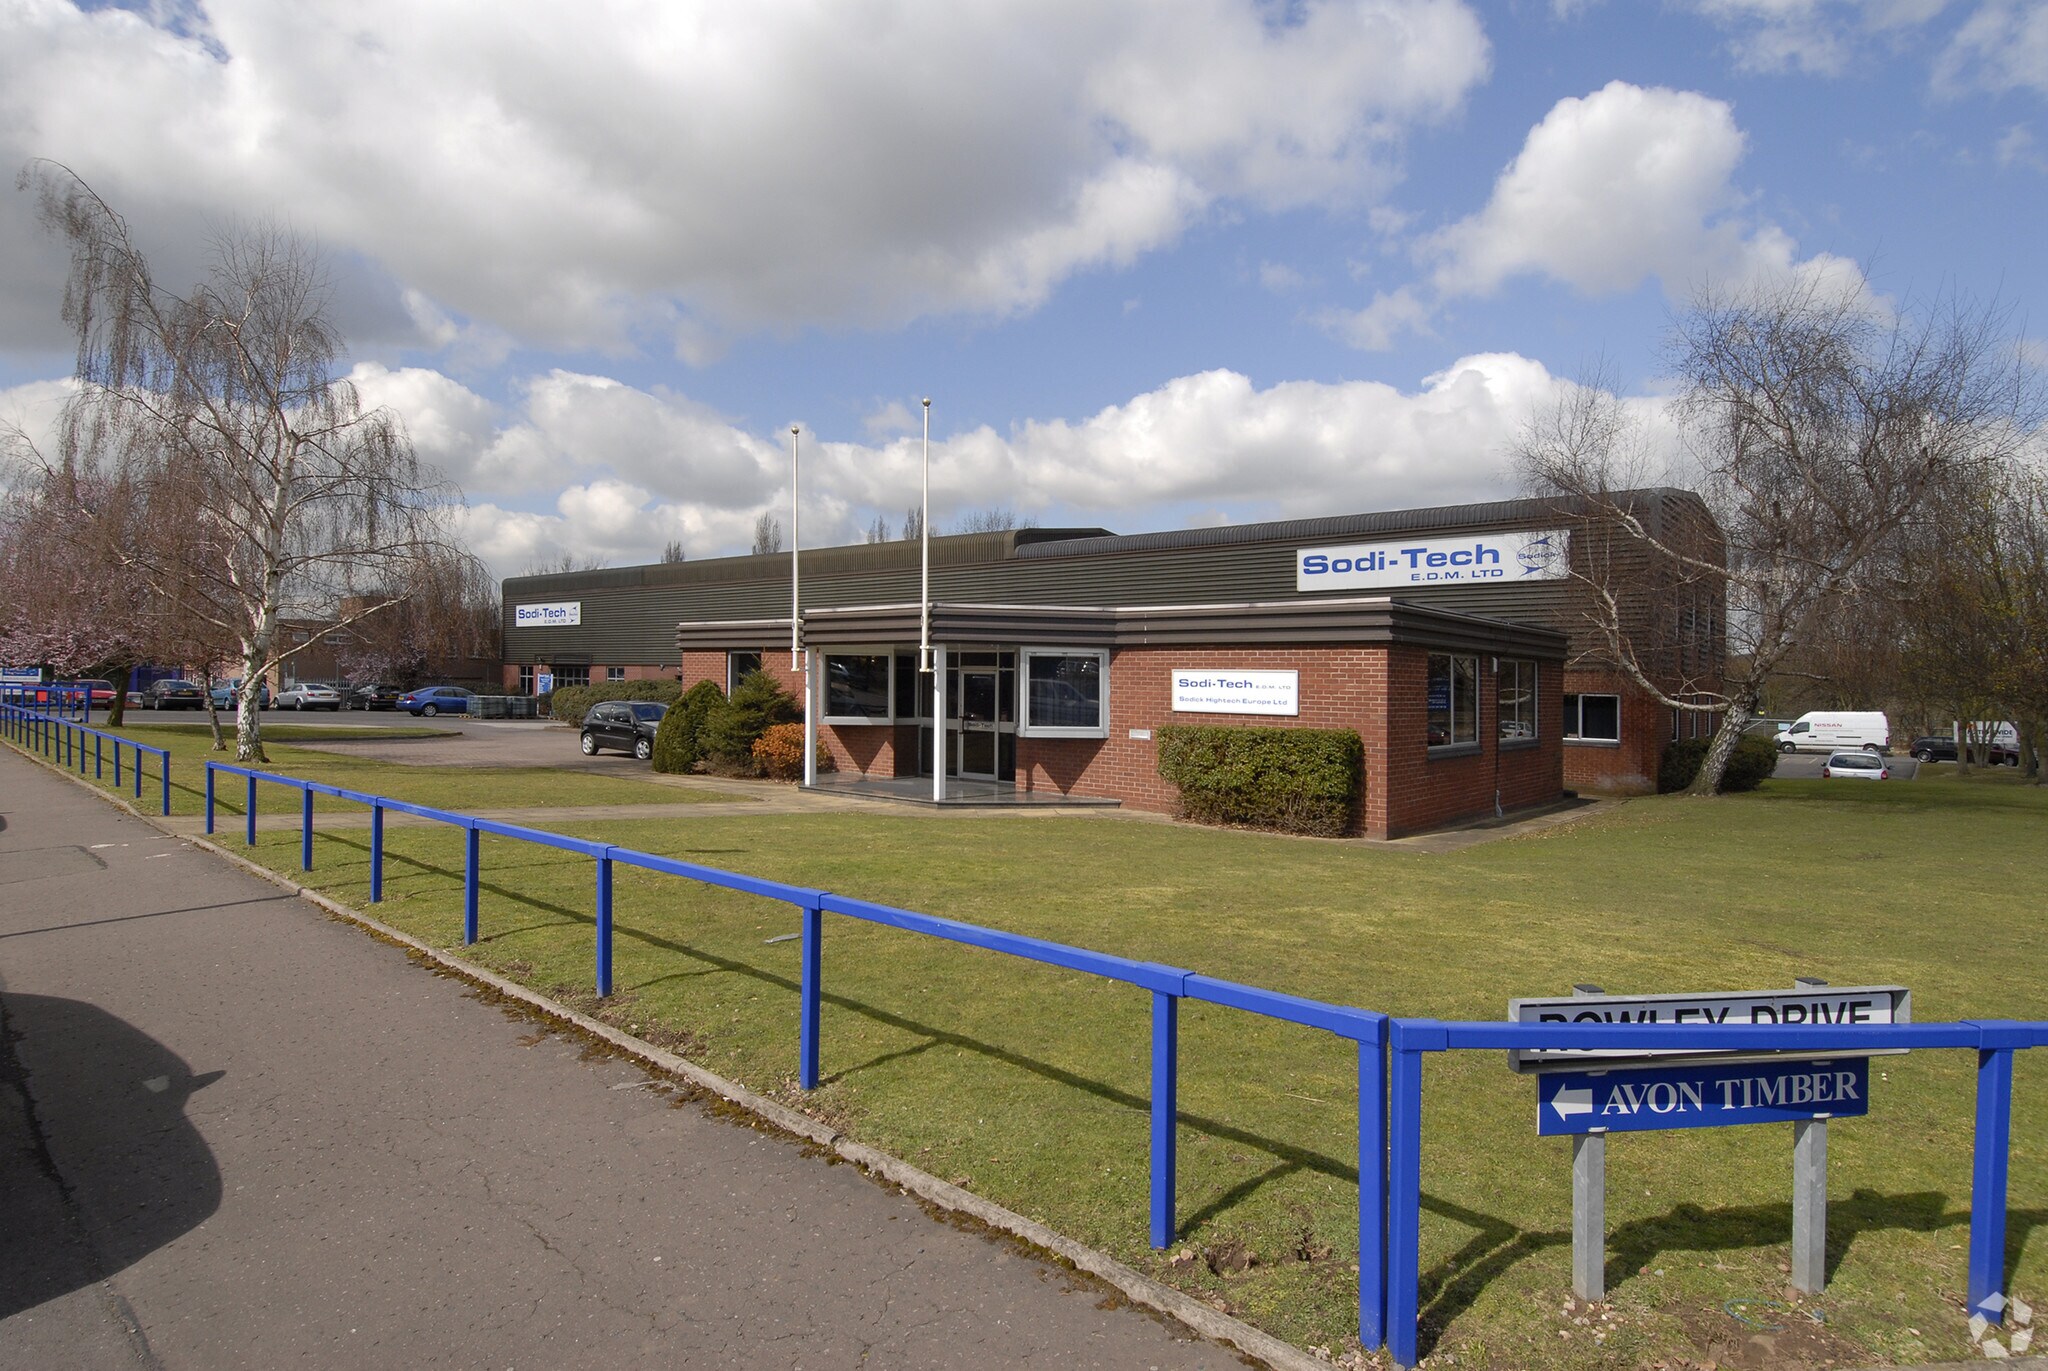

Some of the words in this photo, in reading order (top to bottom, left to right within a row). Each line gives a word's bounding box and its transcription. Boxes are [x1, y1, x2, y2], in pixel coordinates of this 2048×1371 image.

[1303, 544, 1499, 575] Sodi-Tech
[1411, 571, 1464, 581] E.D.M.
[1472, 569, 1503, 578] LTD
[518, 607, 566, 619] Sodi-Tech
[1179, 678, 1253, 688] Sodi-Tech
[1601, 1081, 1704, 1115] AVON
[1715, 1071, 1860, 1111] TIMBER
